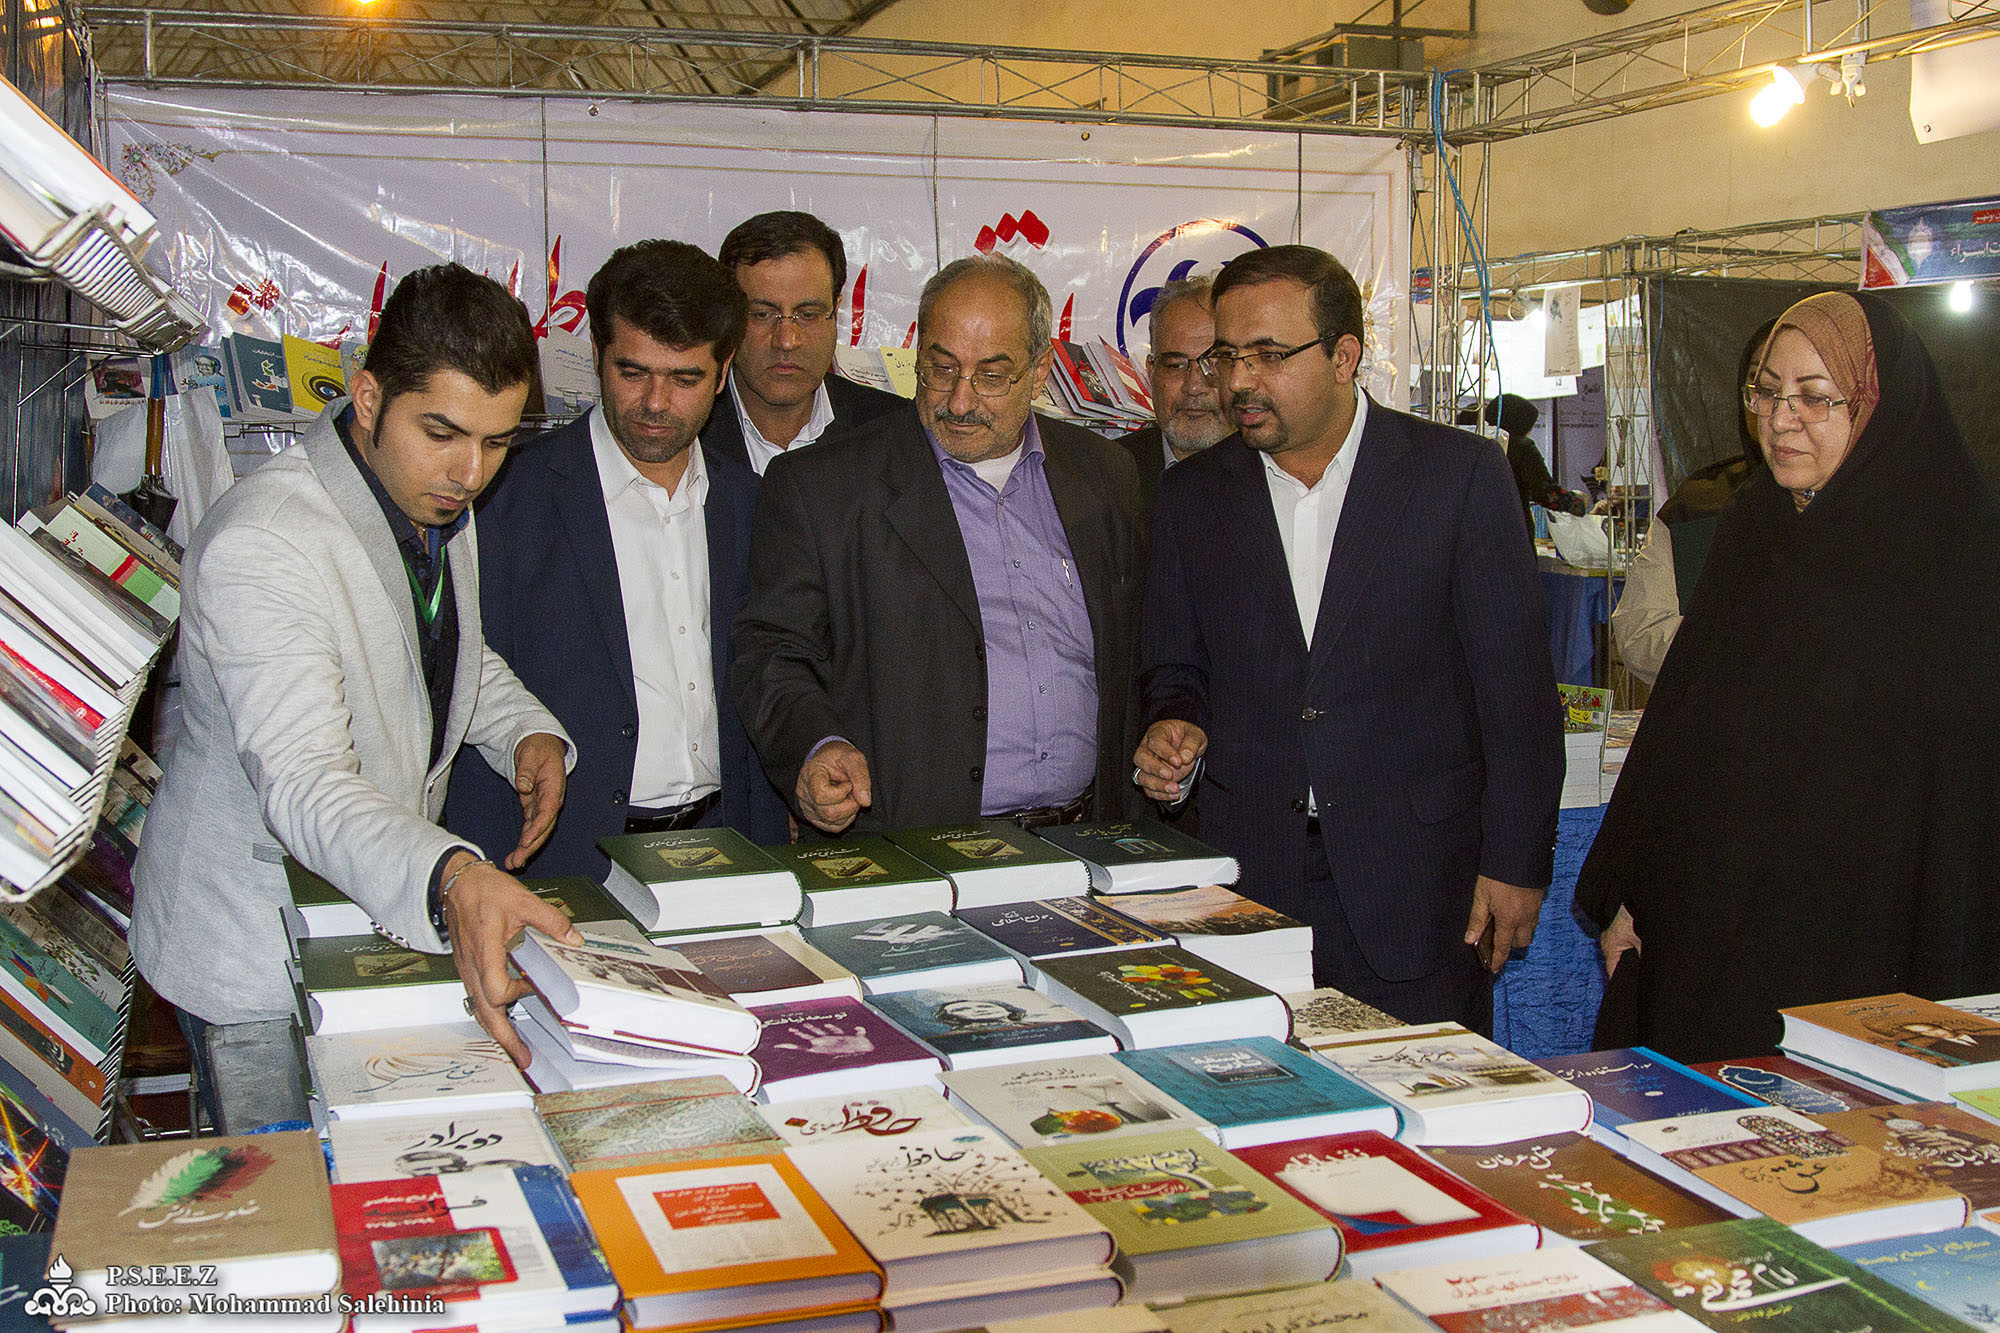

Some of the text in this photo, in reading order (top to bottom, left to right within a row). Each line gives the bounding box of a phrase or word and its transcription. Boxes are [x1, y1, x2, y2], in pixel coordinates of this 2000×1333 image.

[831, 1099, 924, 1137] حافظ
[405, 1120, 504, 1151] دو برادر
[898, 1145, 968, 1169] حافظ
